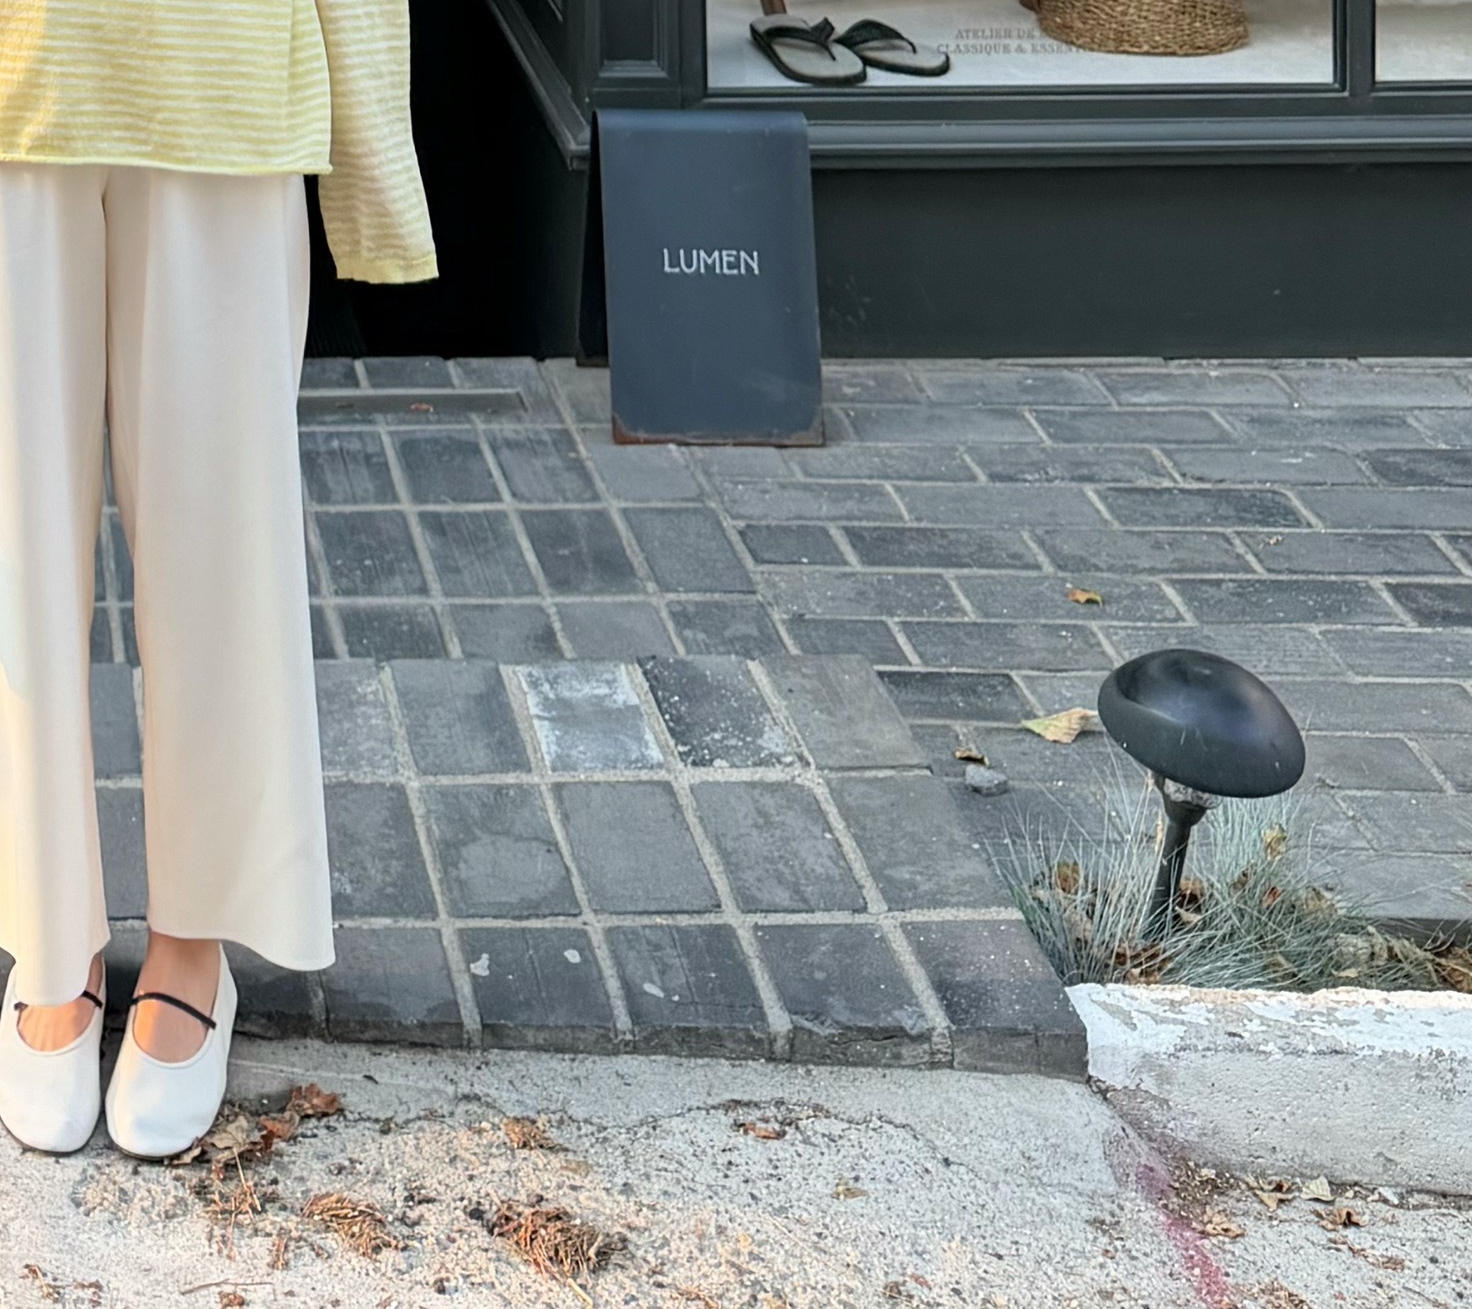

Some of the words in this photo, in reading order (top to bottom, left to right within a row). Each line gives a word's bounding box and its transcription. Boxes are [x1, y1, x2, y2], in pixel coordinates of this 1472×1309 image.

[955, 27, 1013, 40] ATELIER
[936, 43, 1011, 55] CLASSIQUE
[663, 248, 759, 275] LUMEN
